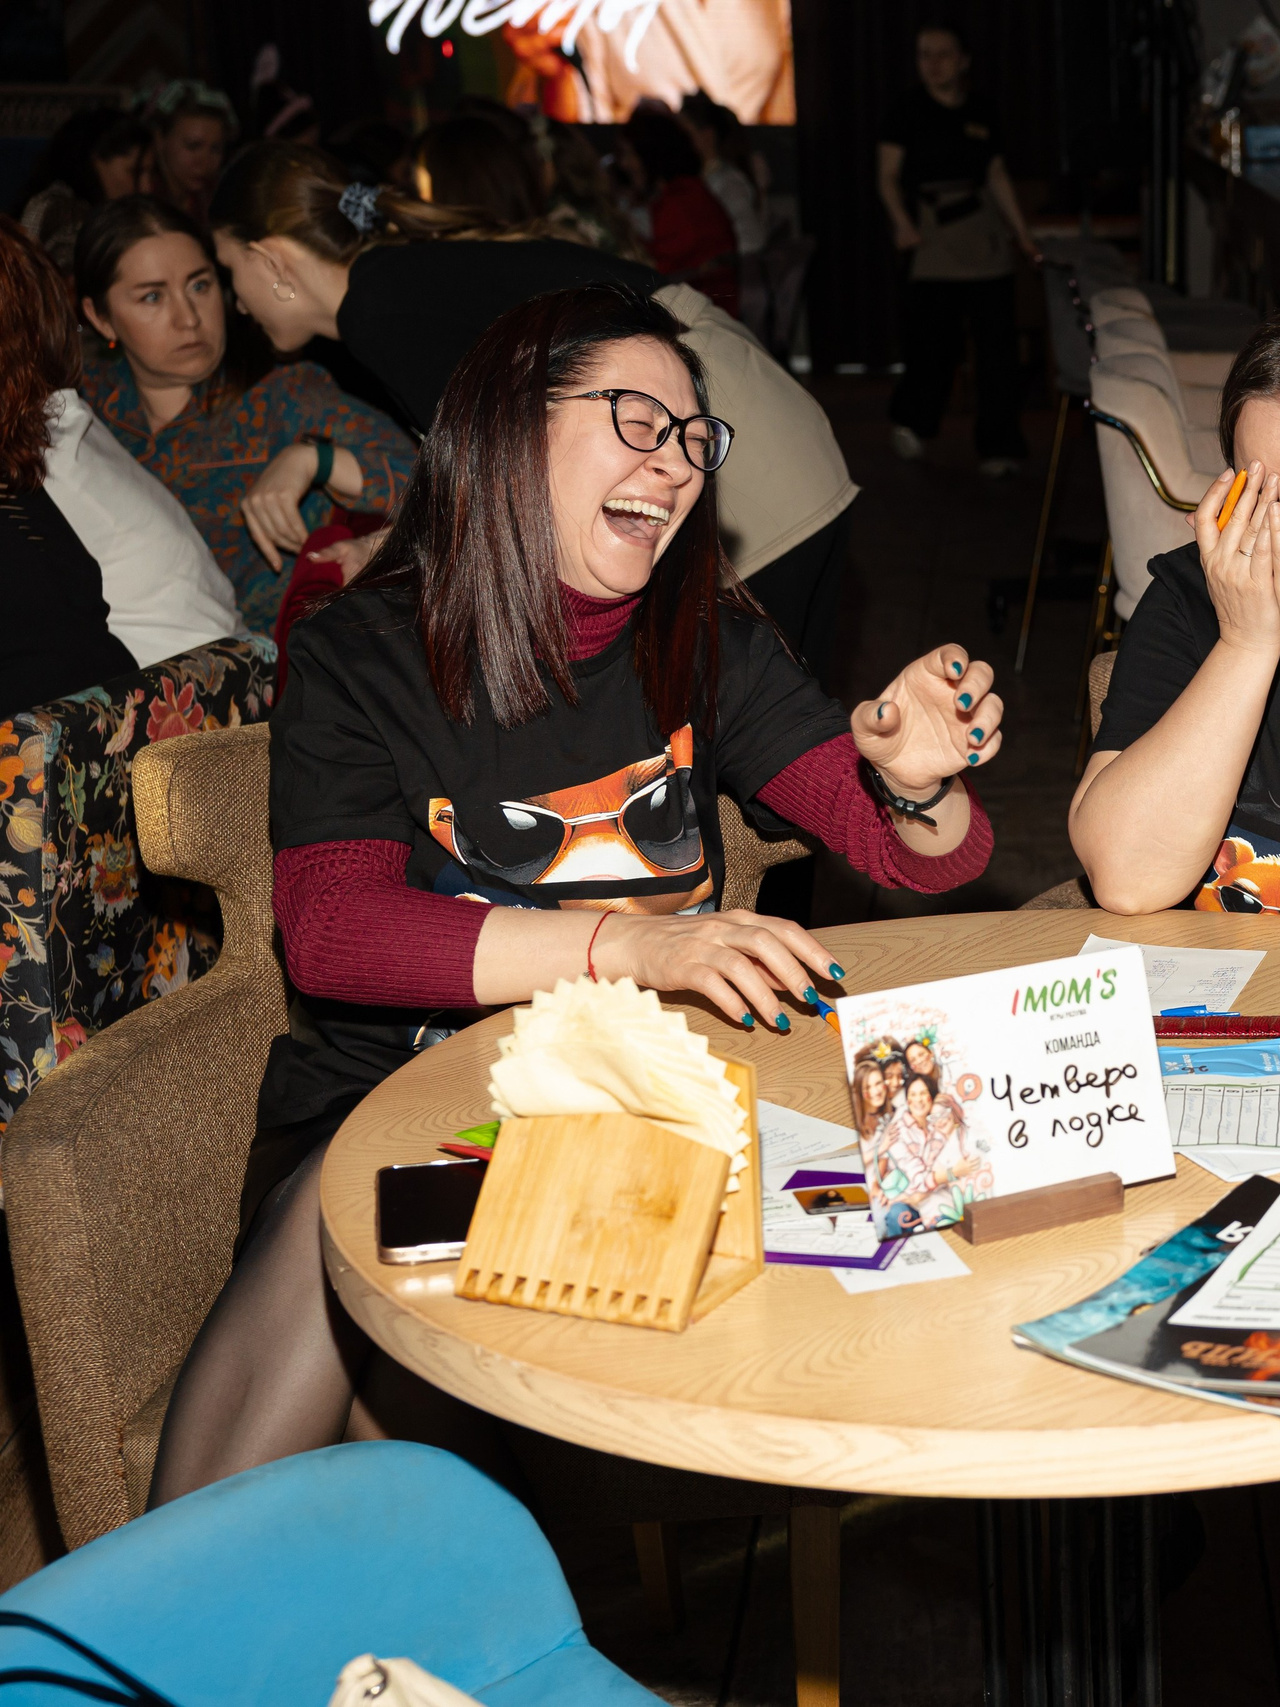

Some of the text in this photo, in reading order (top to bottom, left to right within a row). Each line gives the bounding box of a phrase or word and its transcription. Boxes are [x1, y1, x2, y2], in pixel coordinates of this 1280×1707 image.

[1044, 1031, 1101, 1055] КОМАНДА
[991, 1063, 1138, 1111] Четверо
[1008, 1119, 1029, 1149] в
[1052, 1103, 1145, 1148] лодке
